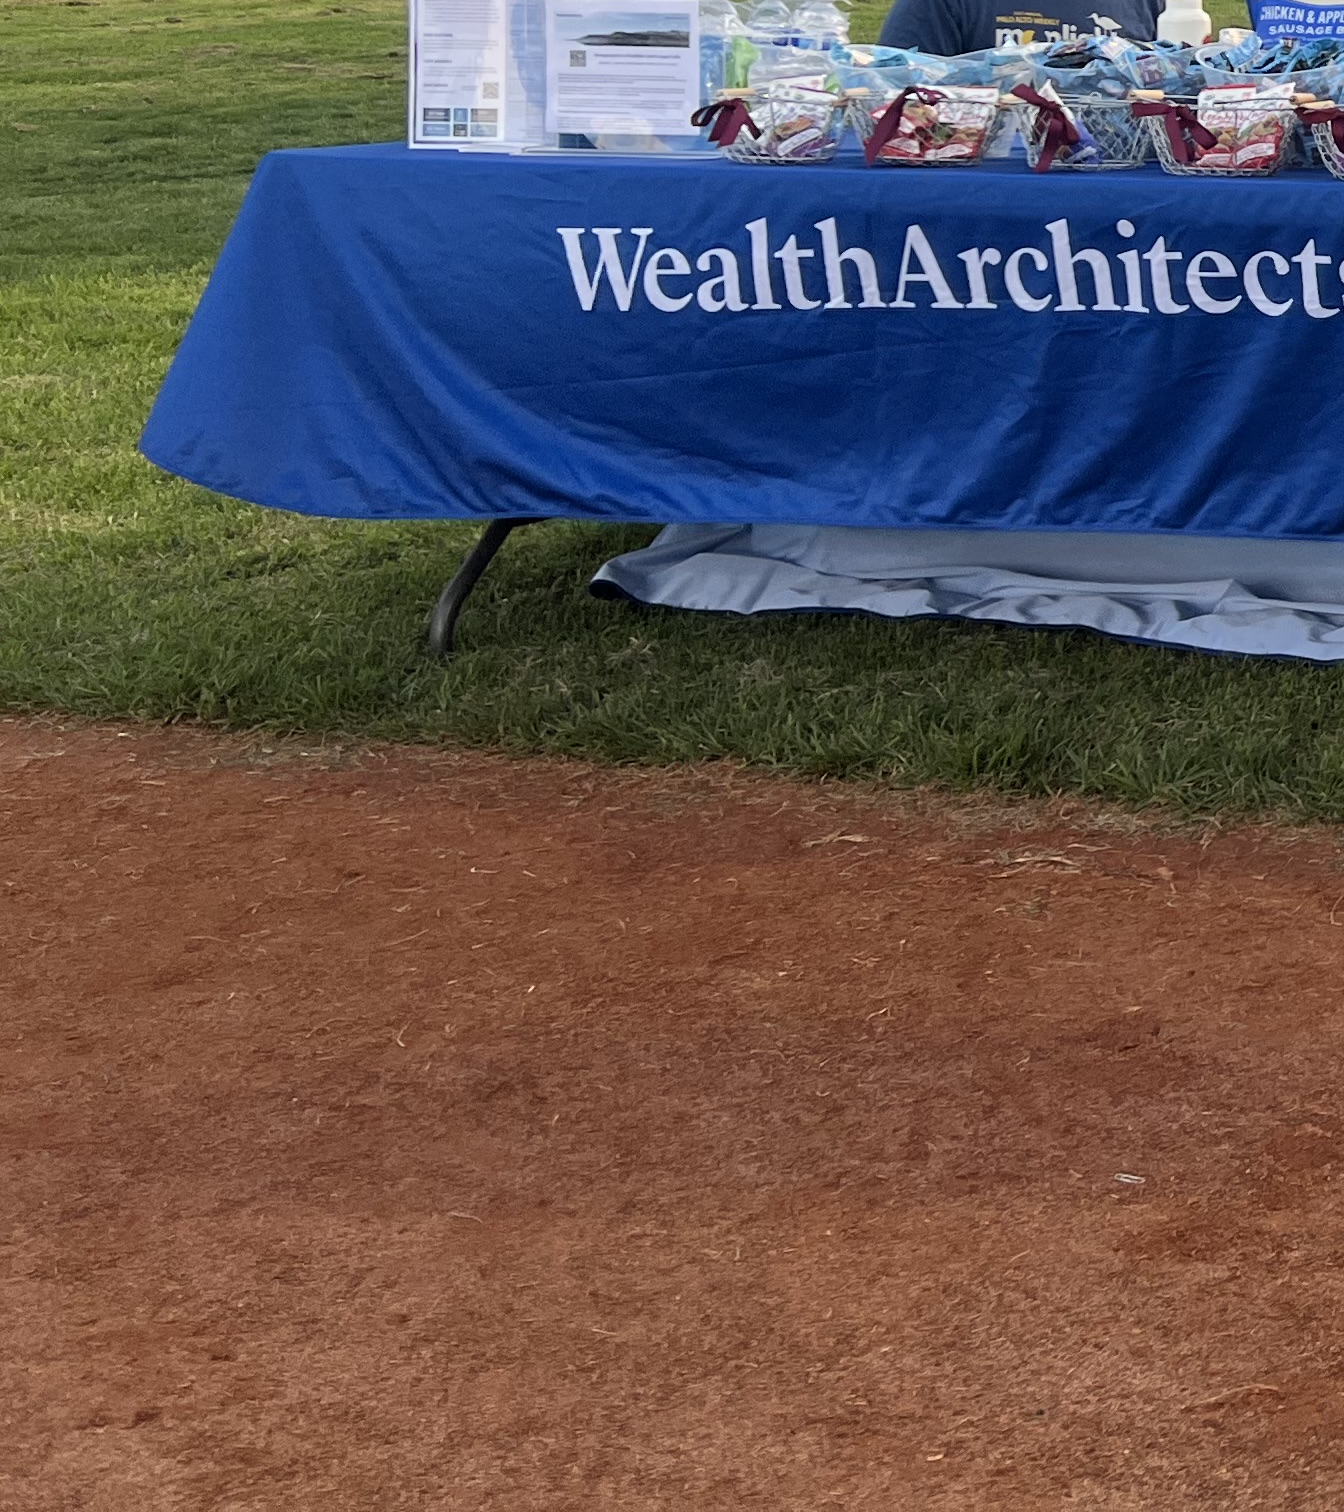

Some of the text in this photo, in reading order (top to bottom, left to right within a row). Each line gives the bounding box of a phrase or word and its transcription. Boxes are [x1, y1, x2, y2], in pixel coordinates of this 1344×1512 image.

[1260, 5, 1305, 23] CHICKEN
[1306, 9, 1316, 24] &
[1268, 24, 1332, 36] SAUSAGE
